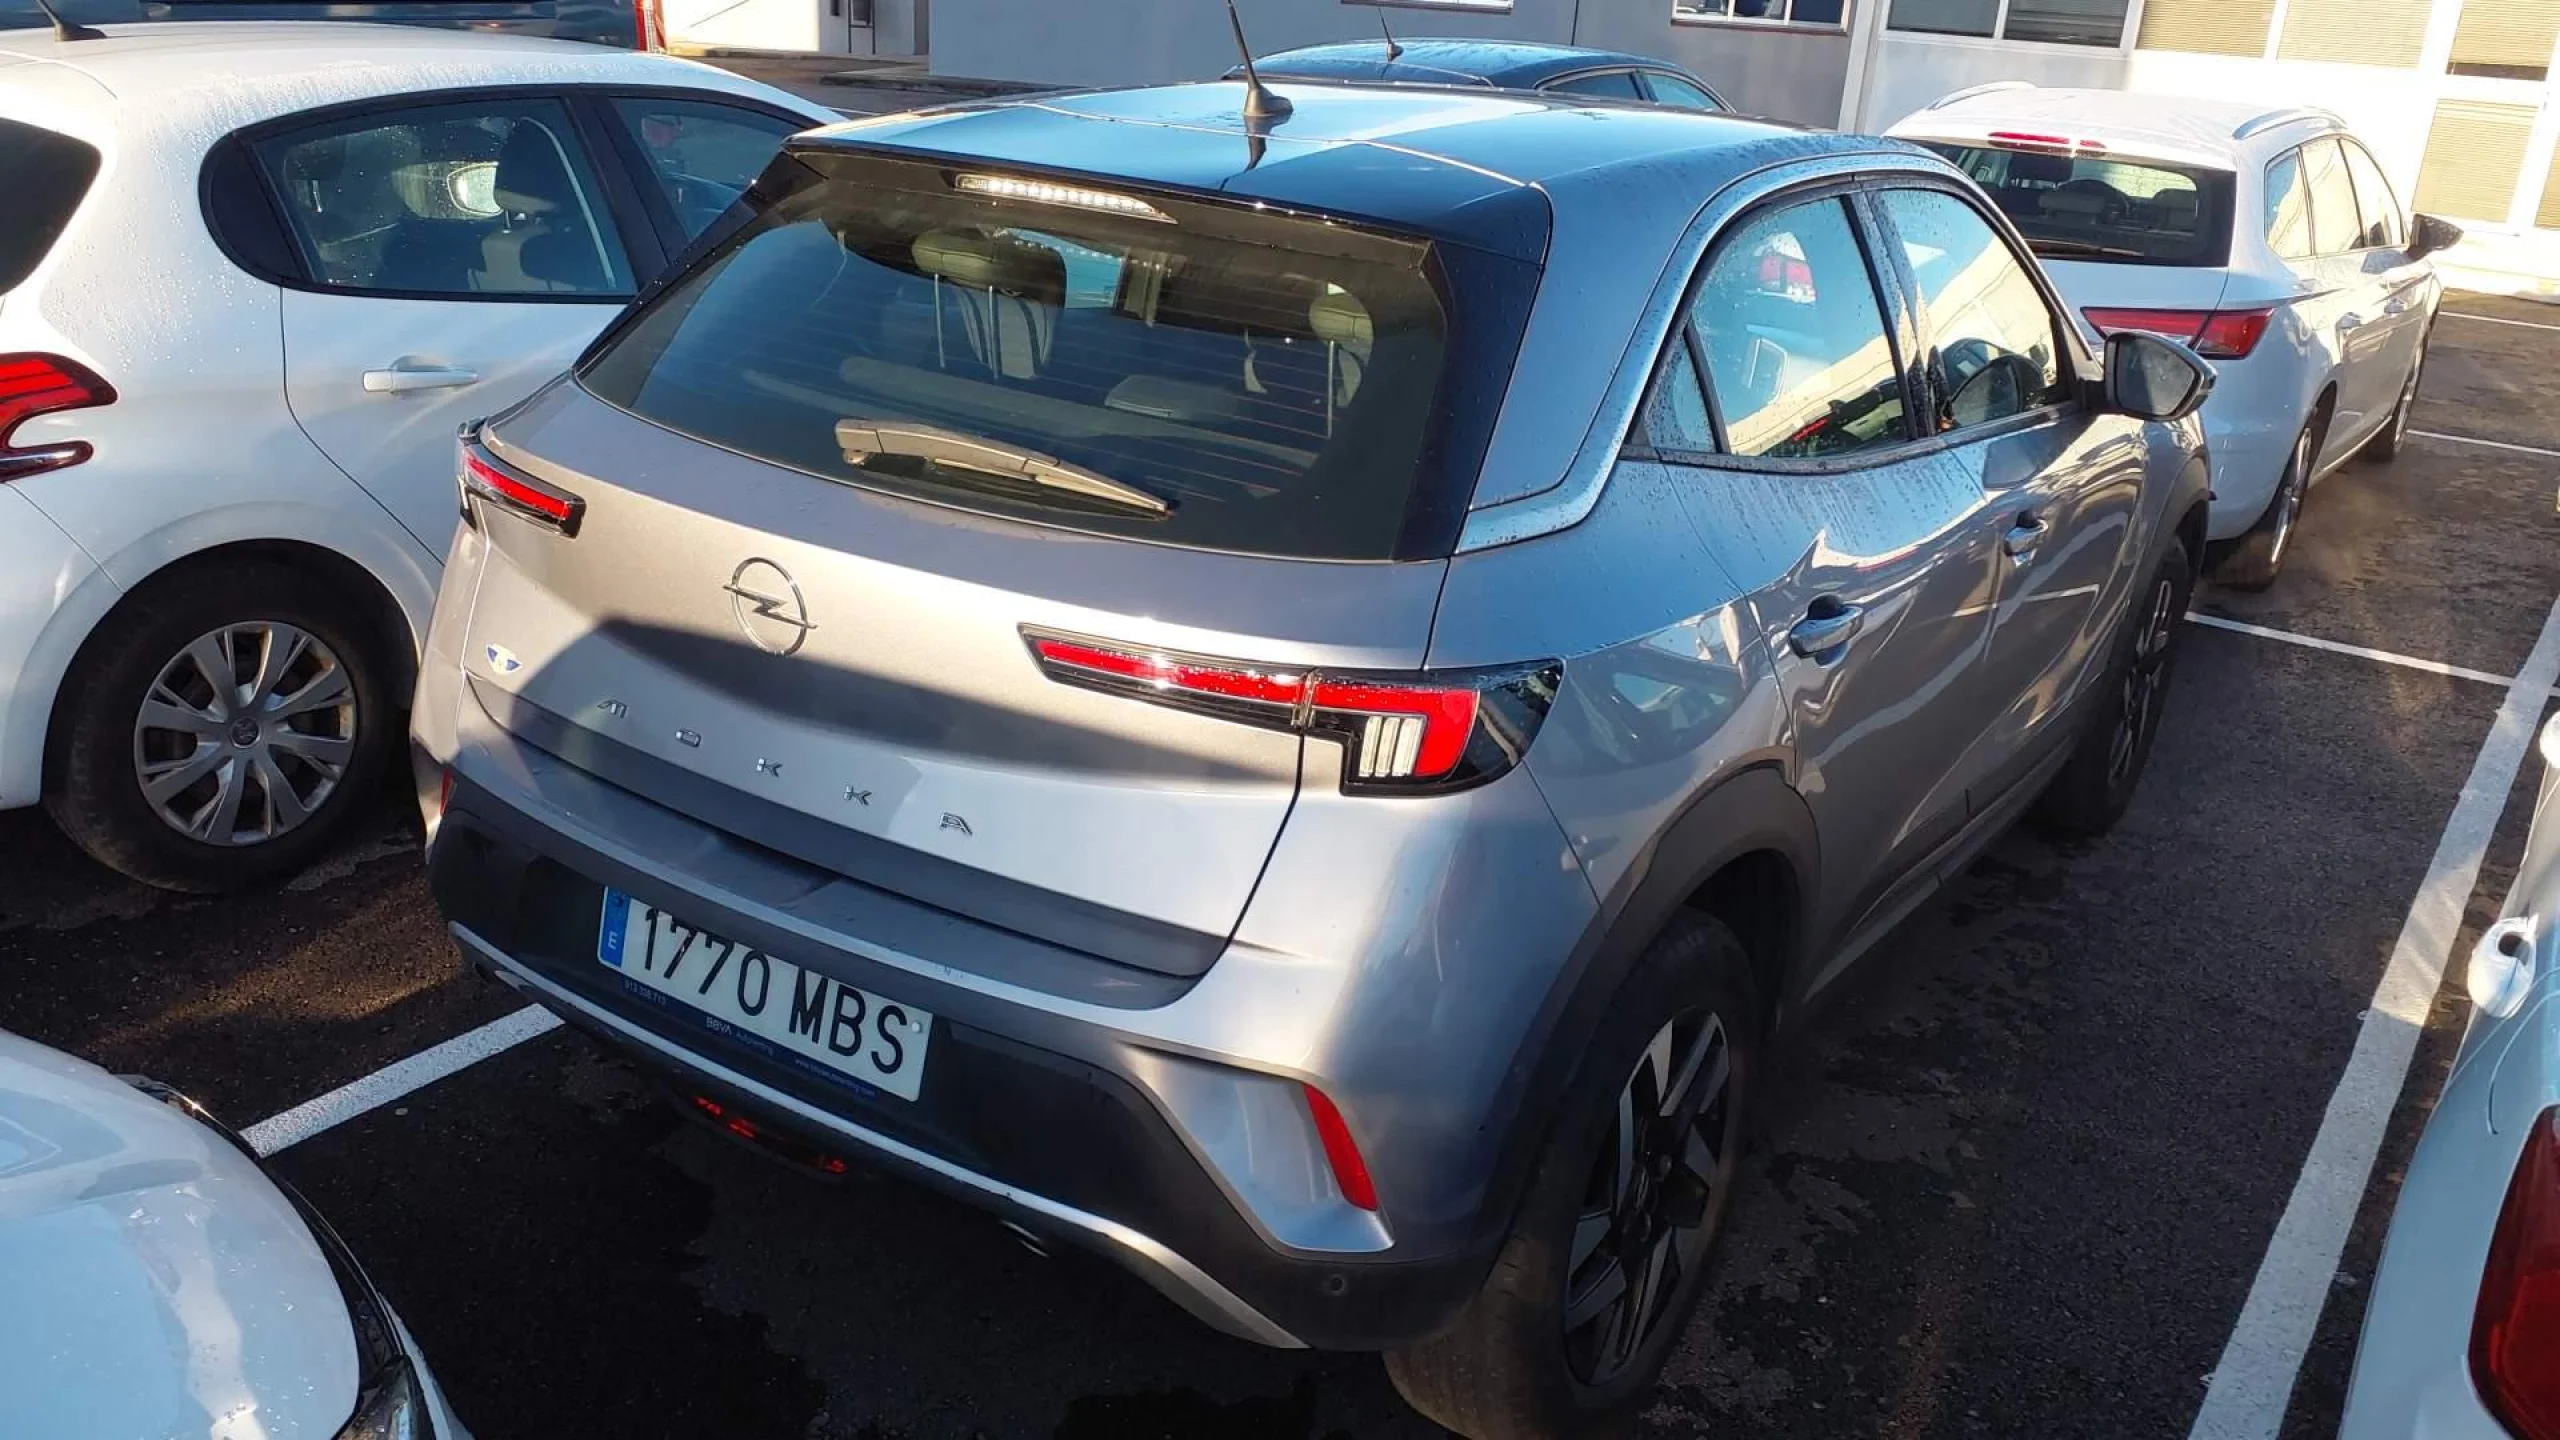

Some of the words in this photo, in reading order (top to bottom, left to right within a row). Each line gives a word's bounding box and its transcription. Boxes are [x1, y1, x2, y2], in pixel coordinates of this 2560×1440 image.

[597, 699, 973, 836] MOKKA
[607, 930, 618, 950] E
[645, 907, 770, 1016] 1770
[788, 968, 907, 1074] MBS
